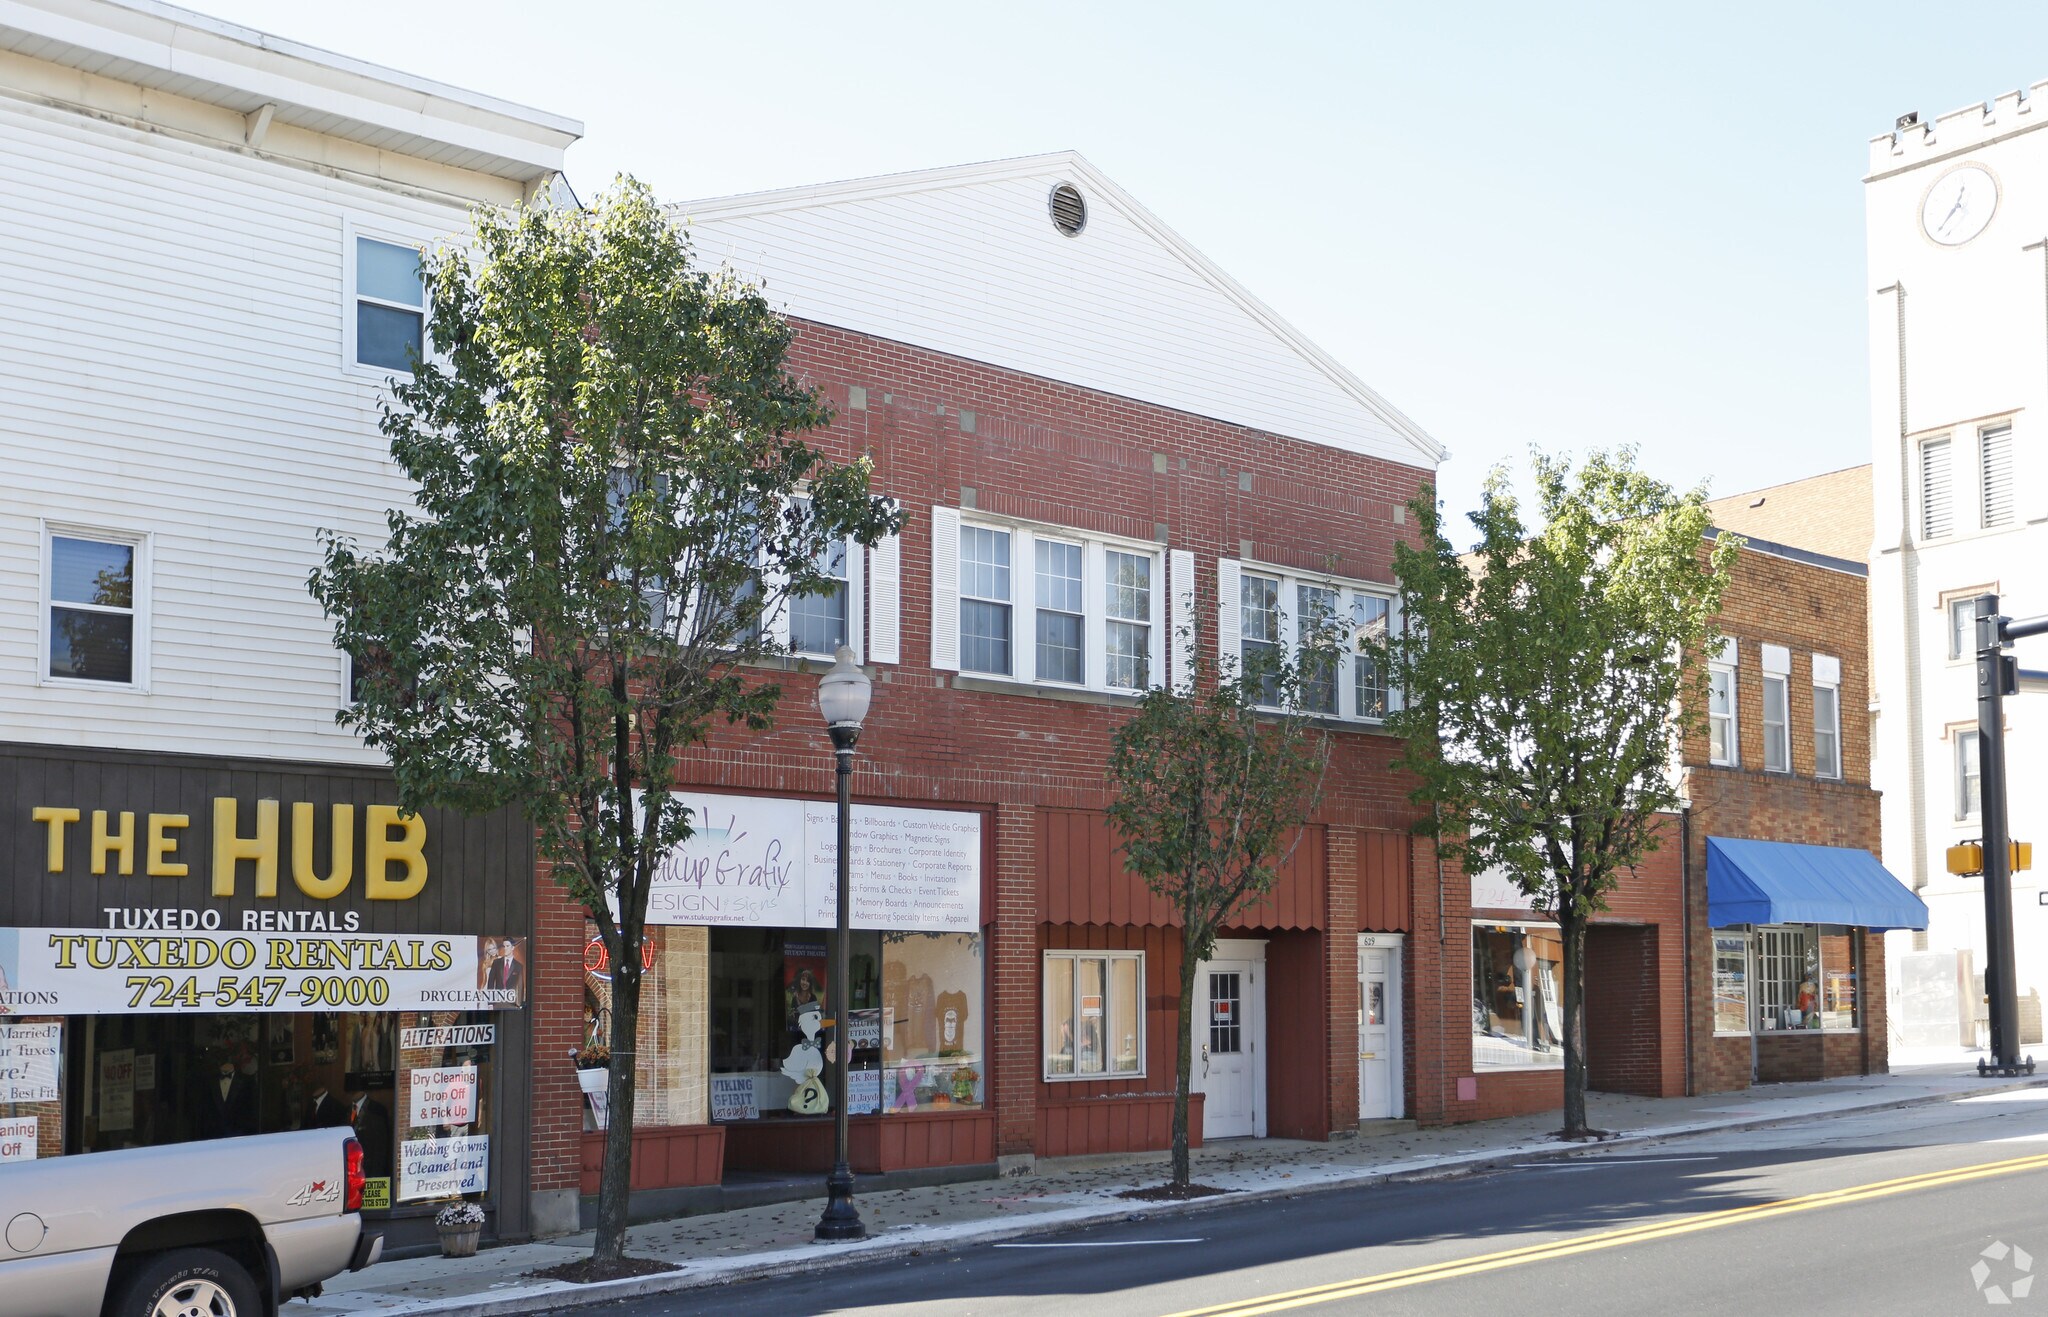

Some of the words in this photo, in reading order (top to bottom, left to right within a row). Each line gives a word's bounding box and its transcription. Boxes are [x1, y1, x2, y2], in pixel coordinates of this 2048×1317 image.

[806, 813, 823, 824] Signs
[831, 815, 857, 824] Baers
[865, 817, 896, 828] Billboards
[903, 820, 927, 829] Custom
[928, 821, 951, 831] Vehicle
[952, 823, 979, 834] Graphics
[849, 831, 868, 839] ndow
[870, 831, 898, 842] Graphics
[905, 833, 933, 844] Magnetic
[934, 835, 950, 846] Signs
[33, 806, 190, 876] THE
[212, 797, 429, 900] HUB
[820, 841, 837, 853] Logo
[849, 844, 862, 854] sign
[868, 844, 901, 854] Brochures
[908, 847, 941, 857] Corporate
[943, 849, 967, 860] Identity
[814, 854, 838, 864] Busine
[849, 857, 864, 866] ards
[866, 857, 871, 866] &
[873, 858, 906, 869] Stationery
[912, 860, 945, 871] Corporate
[947, 862, 972, 872] Reports
[832, 868, 864, 879] Prams
[871, 871, 891, 880] Menus
[898, 873, 918, 881] Books
[924, 874, 957, 884] Invitations
[829, 882, 857, 892] Buess
[860, 884, 879, 893] Forms
[881, 885, 887, 893] &
[888, 885, 912, 895] Checks
[918, 886, 936, 896] Event
[937, 887, 959, 897] Tickets
[651, 893, 719, 912] ESIGN
[855, 897, 884, 909] Memory
[885, 898, 908, 908] Boards
[913, 900, 964, 910] Announcements
[103, 908, 221, 931] TUXEDO
[242, 910, 360, 932] RENTALS
[672, 913, 745, 923] www.stukupgrafix.net
[818, 909, 835, 918] Print
[854, 910, 891, 923] Advertising
[892, 912, 920, 923] Specialty
[922, 913, 940, 922] Items
[944, 914, 969, 924] Apparel
[1363, 936, 1376, 947] 629
[49, 934, 256, 970] TUXEDO
[265, 938, 453, 970] RENTALS
[584, 940, 655, 971] ON
[126, 976, 390, 1008] 724-547-9000
[420, 989, 516, 1003] DRYCLEANING
[402, 1025, 493, 1047] ALTERATIONS
[848, 1028, 880, 1038] ETERANS
[16, 1044, 56, 1056] Tuxes
[413, 1073, 431, 1088] Dry
[433, 1070, 476, 1085] Cleaning
[864, 1071, 896, 1082] Renals
[10, 1086, 35, 1100] Best
[40, 1085, 54, 1098] Fit
[712, 1078, 753, 1092] VIKING
[424, 1090, 448, 1103] Drop
[450, 1087, 466, 1100] Off
[714, 1093, 753, 1106] SPIRIT
[420, 1107, 428, 1120] &
[431, 1105, 452, 1118] Pick
[454, 1105, 468, 1119] Up
[1, 1142, 22, 1156] Off
[404, 1142, 450, 1158] Wedding
[452, 1139, 488, 1153] Gowns
[407, 1158, 457, 1175] Cleaned
[460, 1156, 484, 1170] and
[415, 1173, 475, 1192] Preserved
[375, 1198, 389, 1207] STEP
